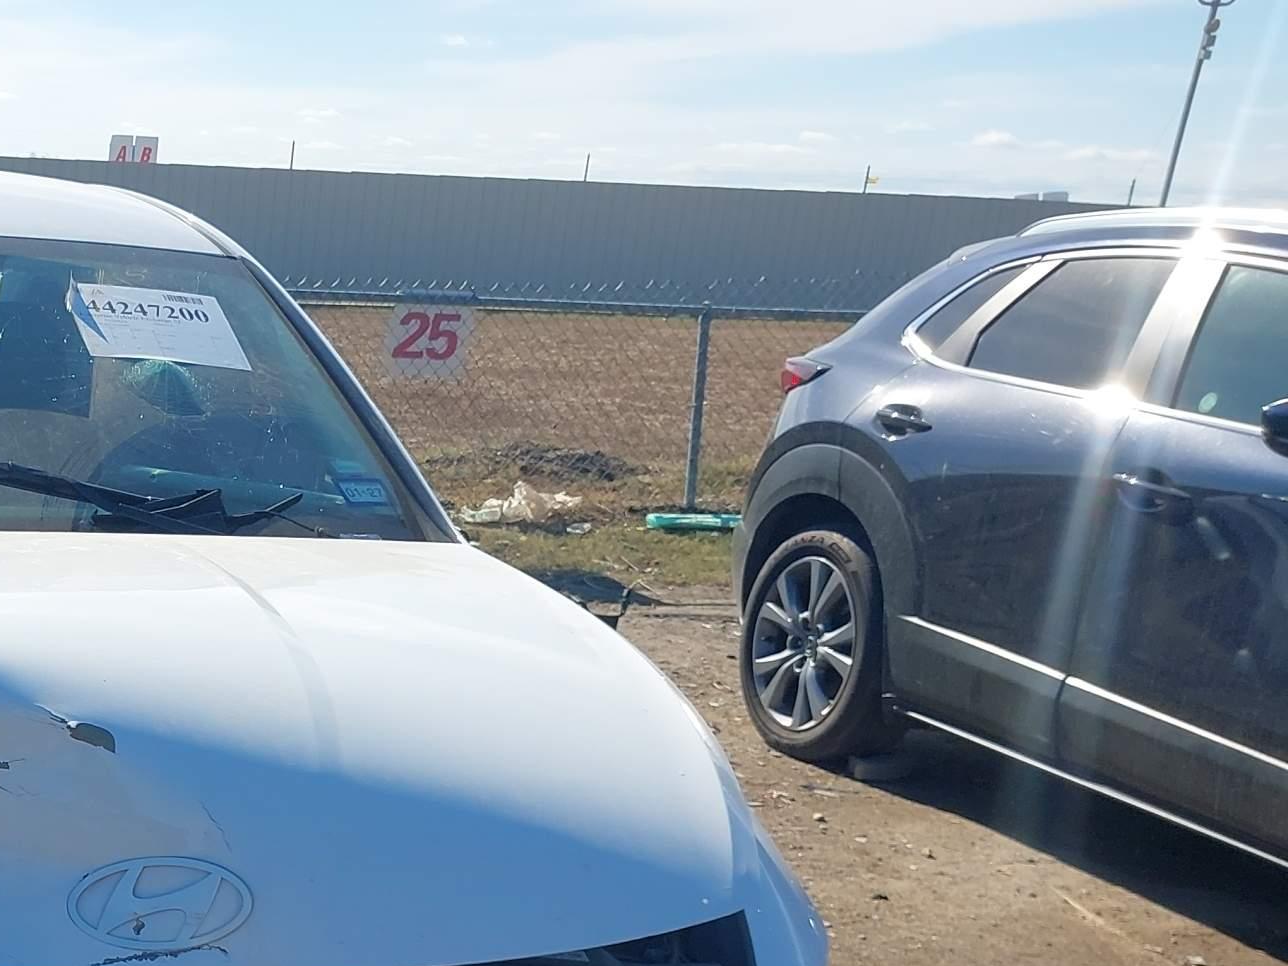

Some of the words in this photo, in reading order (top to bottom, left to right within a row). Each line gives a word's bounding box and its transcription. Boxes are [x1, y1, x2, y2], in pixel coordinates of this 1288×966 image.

[115, 145, 127, 162] A
[139, 146, 153, 163] B
[86, 299, 210, 324] 44247200
[392, 311, 462, 361] 25
